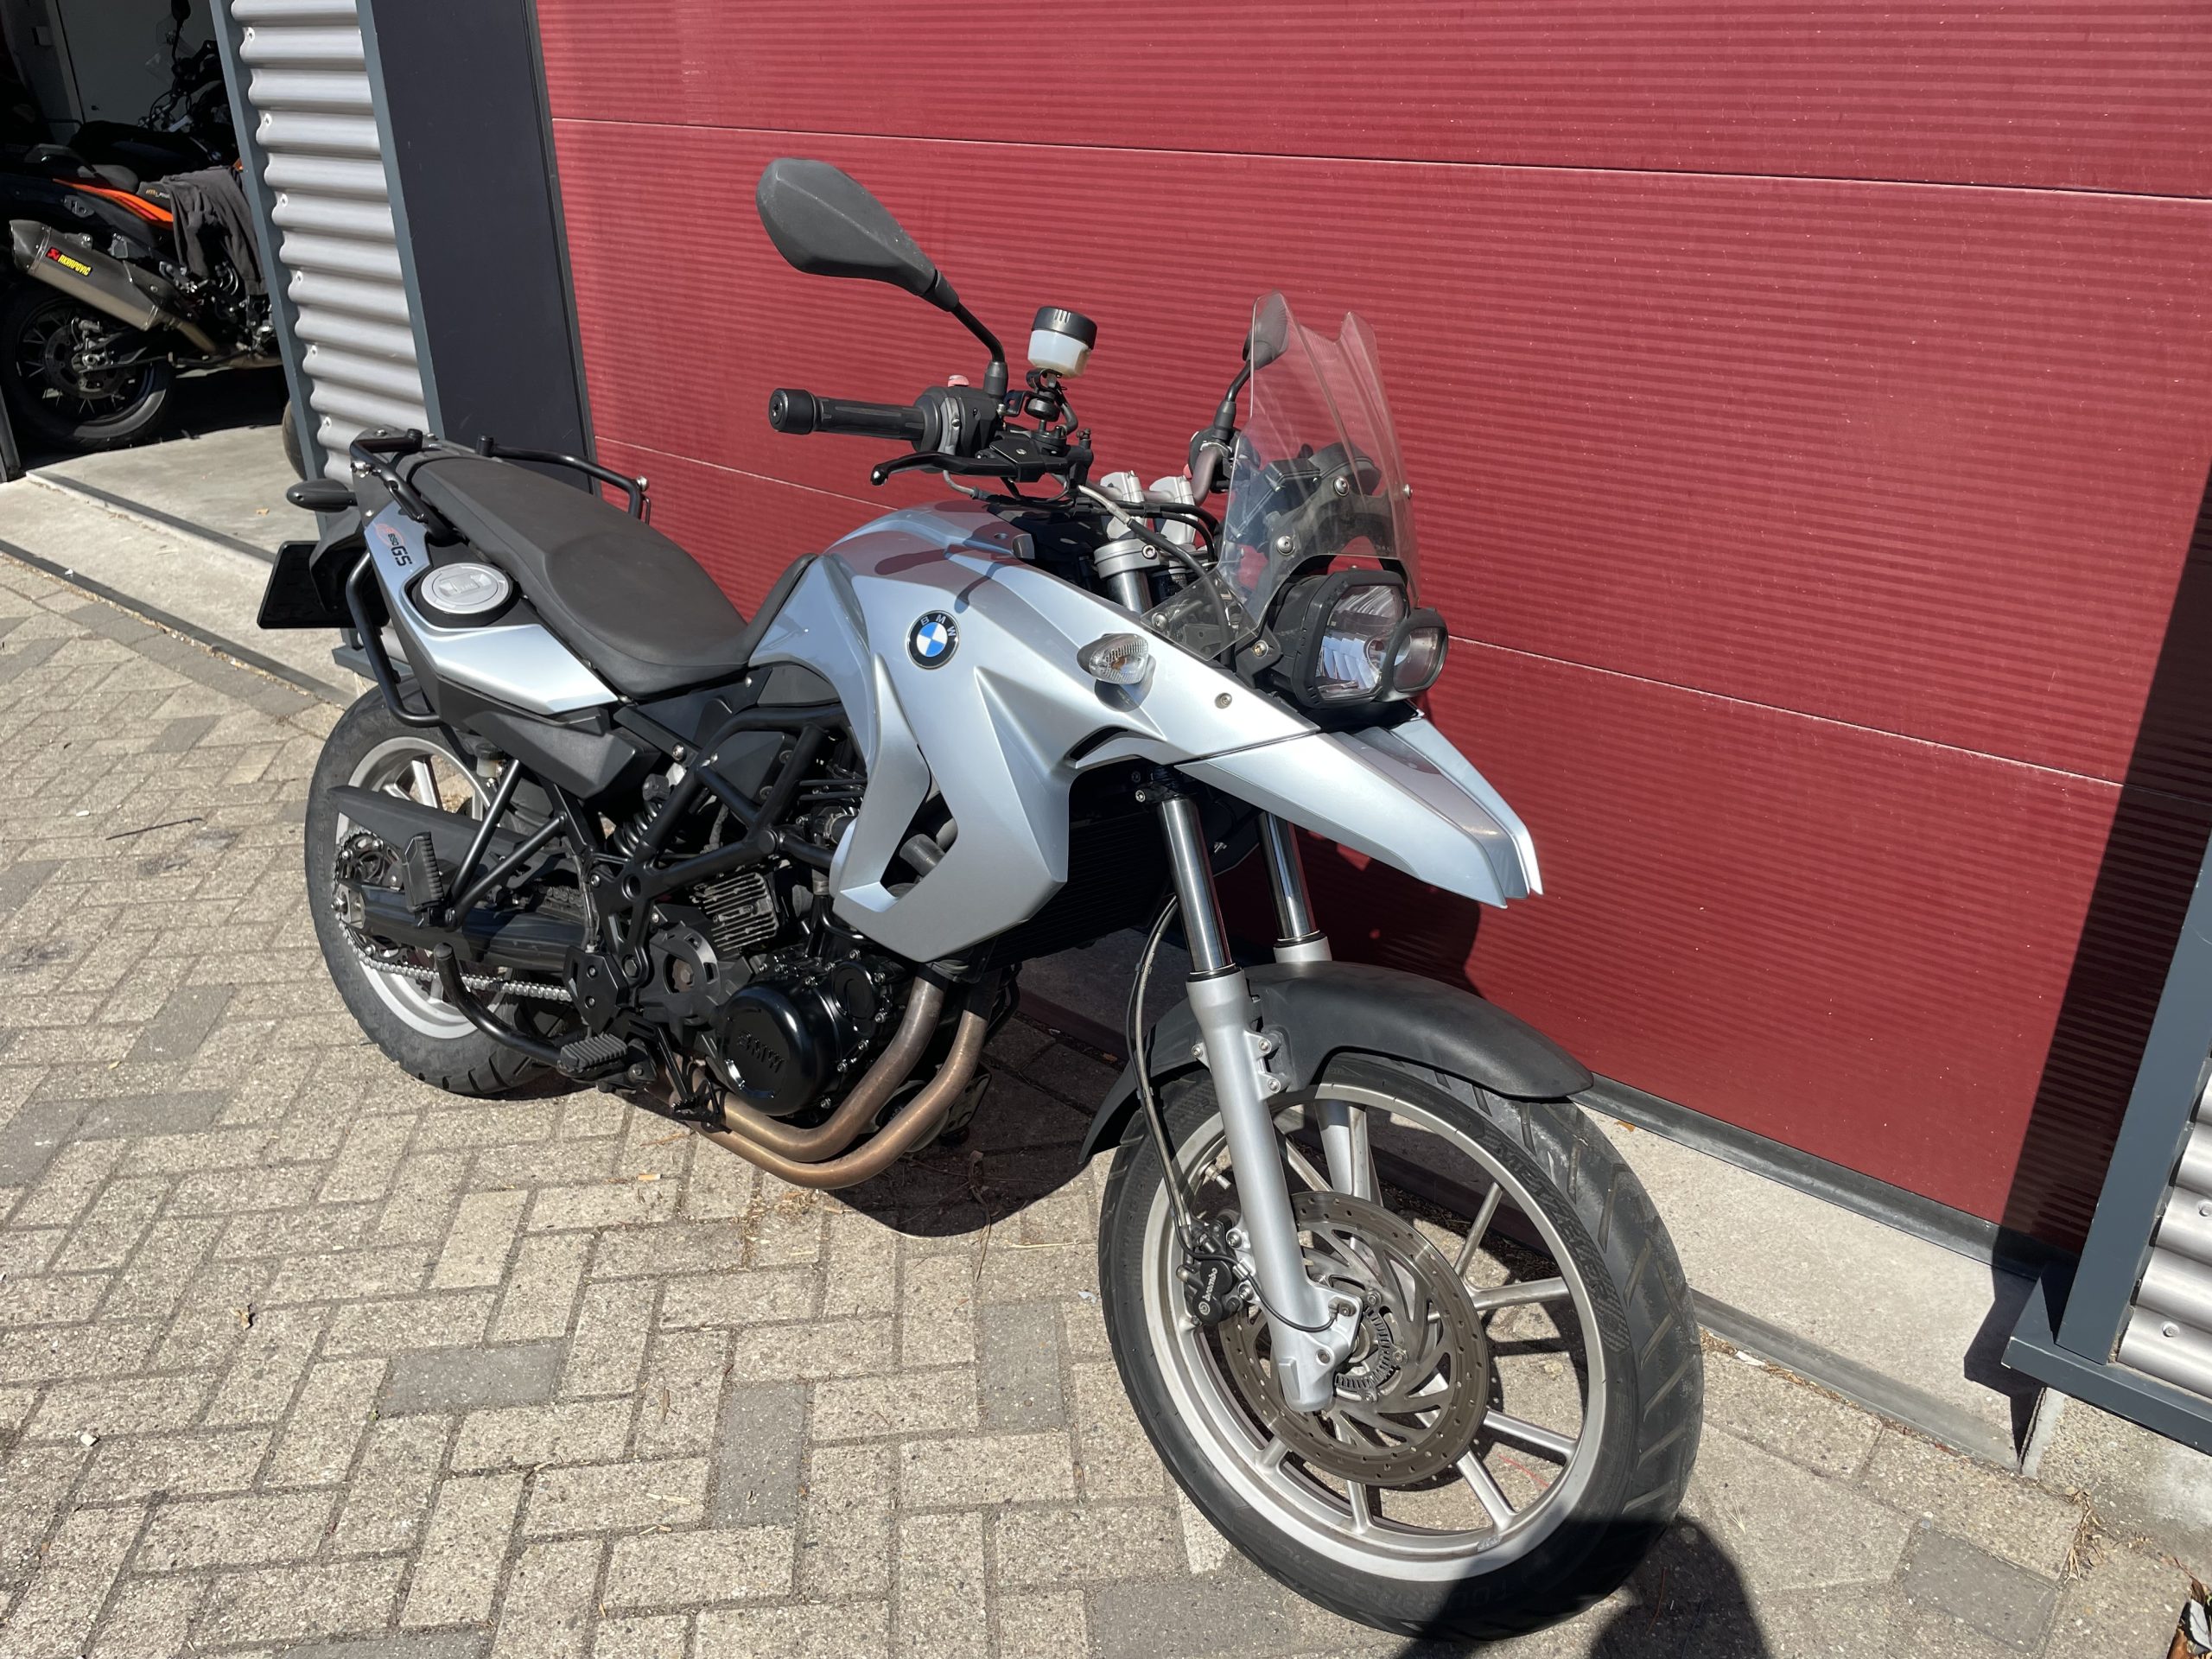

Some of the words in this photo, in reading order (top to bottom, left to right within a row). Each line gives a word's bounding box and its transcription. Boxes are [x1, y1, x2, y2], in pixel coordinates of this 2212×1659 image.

[920, 614, 957, 637] BMW
[737, 1028, 785, 1073] BMW
[1492, 1139, 1611, 1300] METZELER
[1202, 1268, 1218, 1301] brembo
